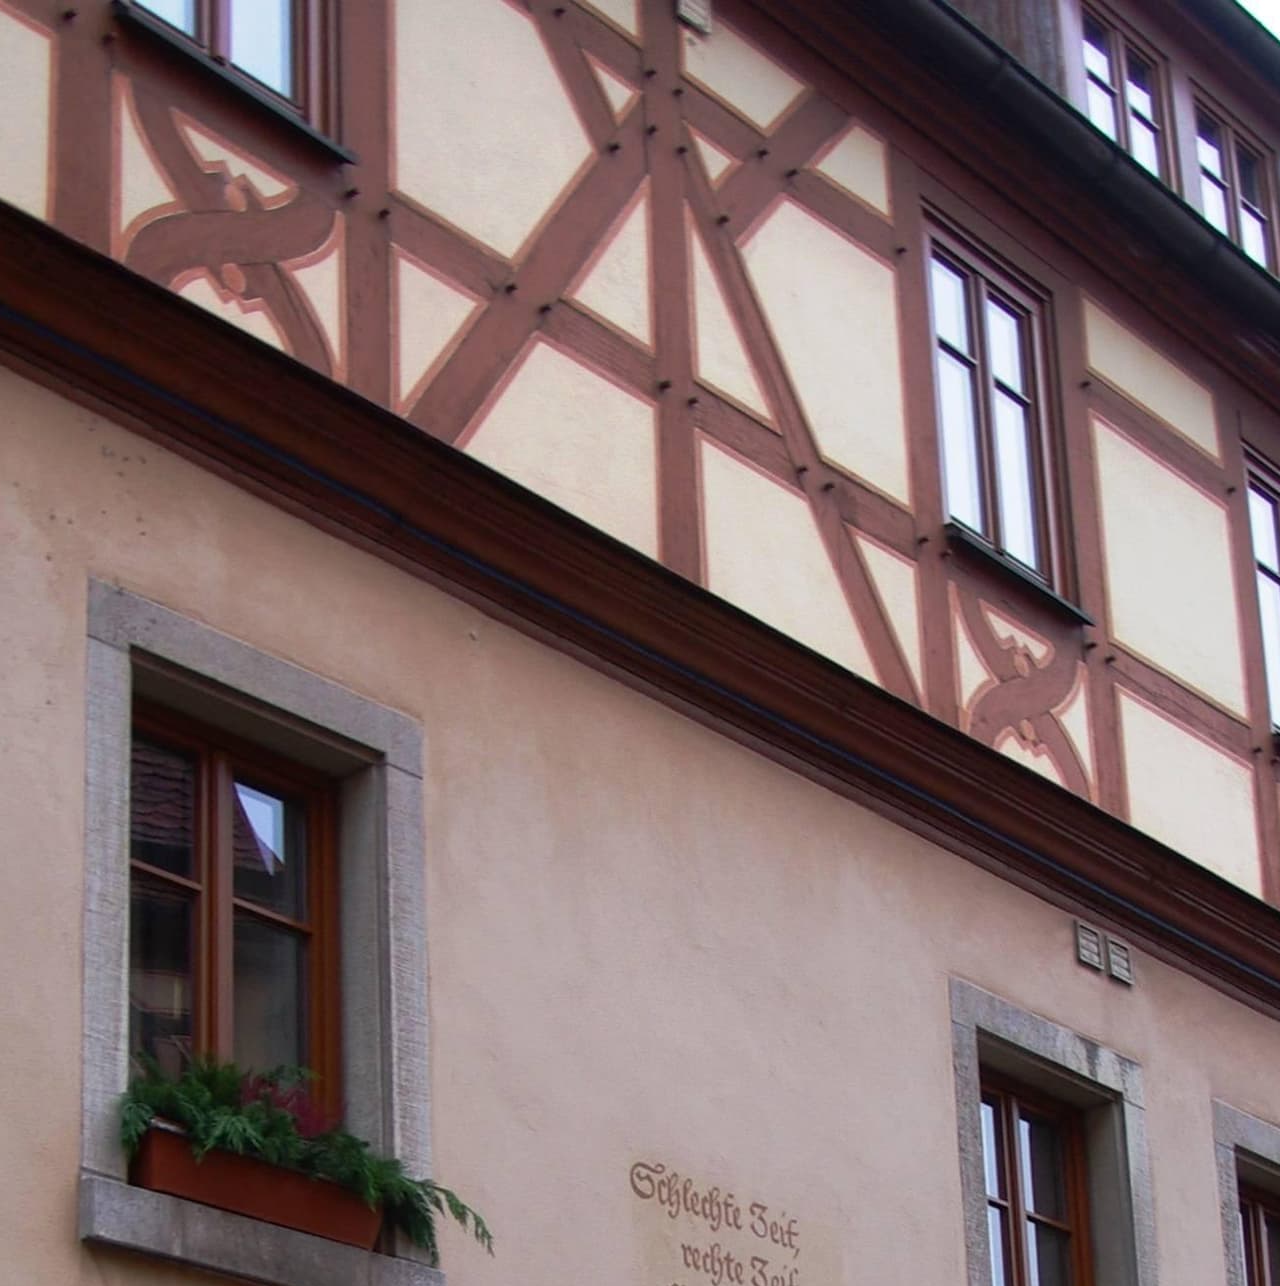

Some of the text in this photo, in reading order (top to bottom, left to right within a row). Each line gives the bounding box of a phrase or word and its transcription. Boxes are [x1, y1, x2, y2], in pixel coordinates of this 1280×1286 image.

[629, 1161, 801, 1259] Schlechte Zeit,
[681, 1241, 744, 1286] rechte
